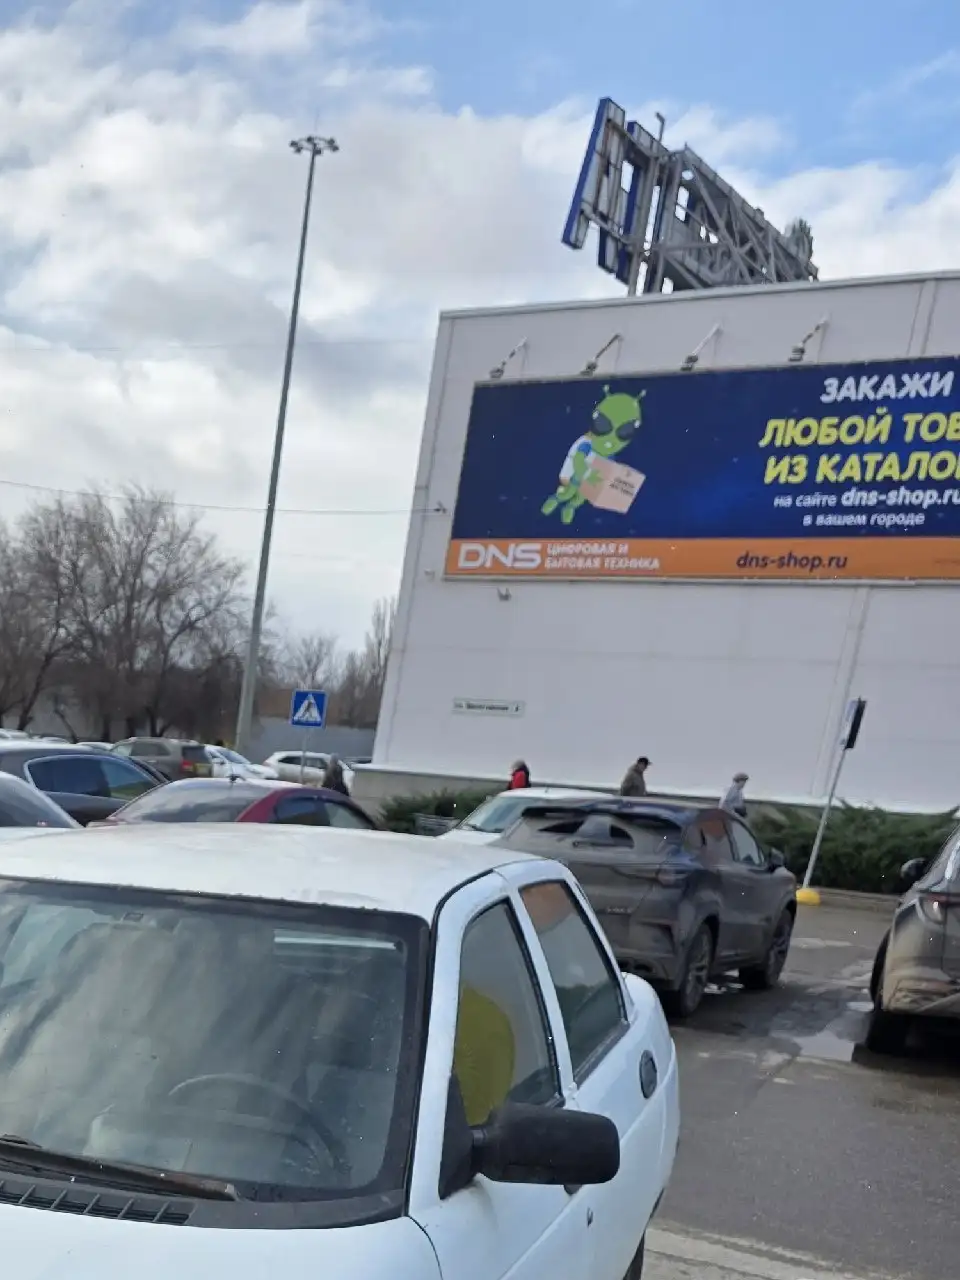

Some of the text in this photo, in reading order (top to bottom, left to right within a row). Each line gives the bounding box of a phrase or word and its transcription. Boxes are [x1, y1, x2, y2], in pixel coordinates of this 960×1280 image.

[820, 371, 954, 403] ЗАКАЖИ
[758, 406, 893, 448] ЛЮБОЙ
[764, 450, 960, 484] ИЗ КАТАЛО
[773, 494, 792, 507] на
[795, 491, 837, 507] сайте
[803, 512, 925, 528] в вашем городе
[458, 542, 542, 569] DNS
[736, 550, 848, 572] dns-shop.ru
